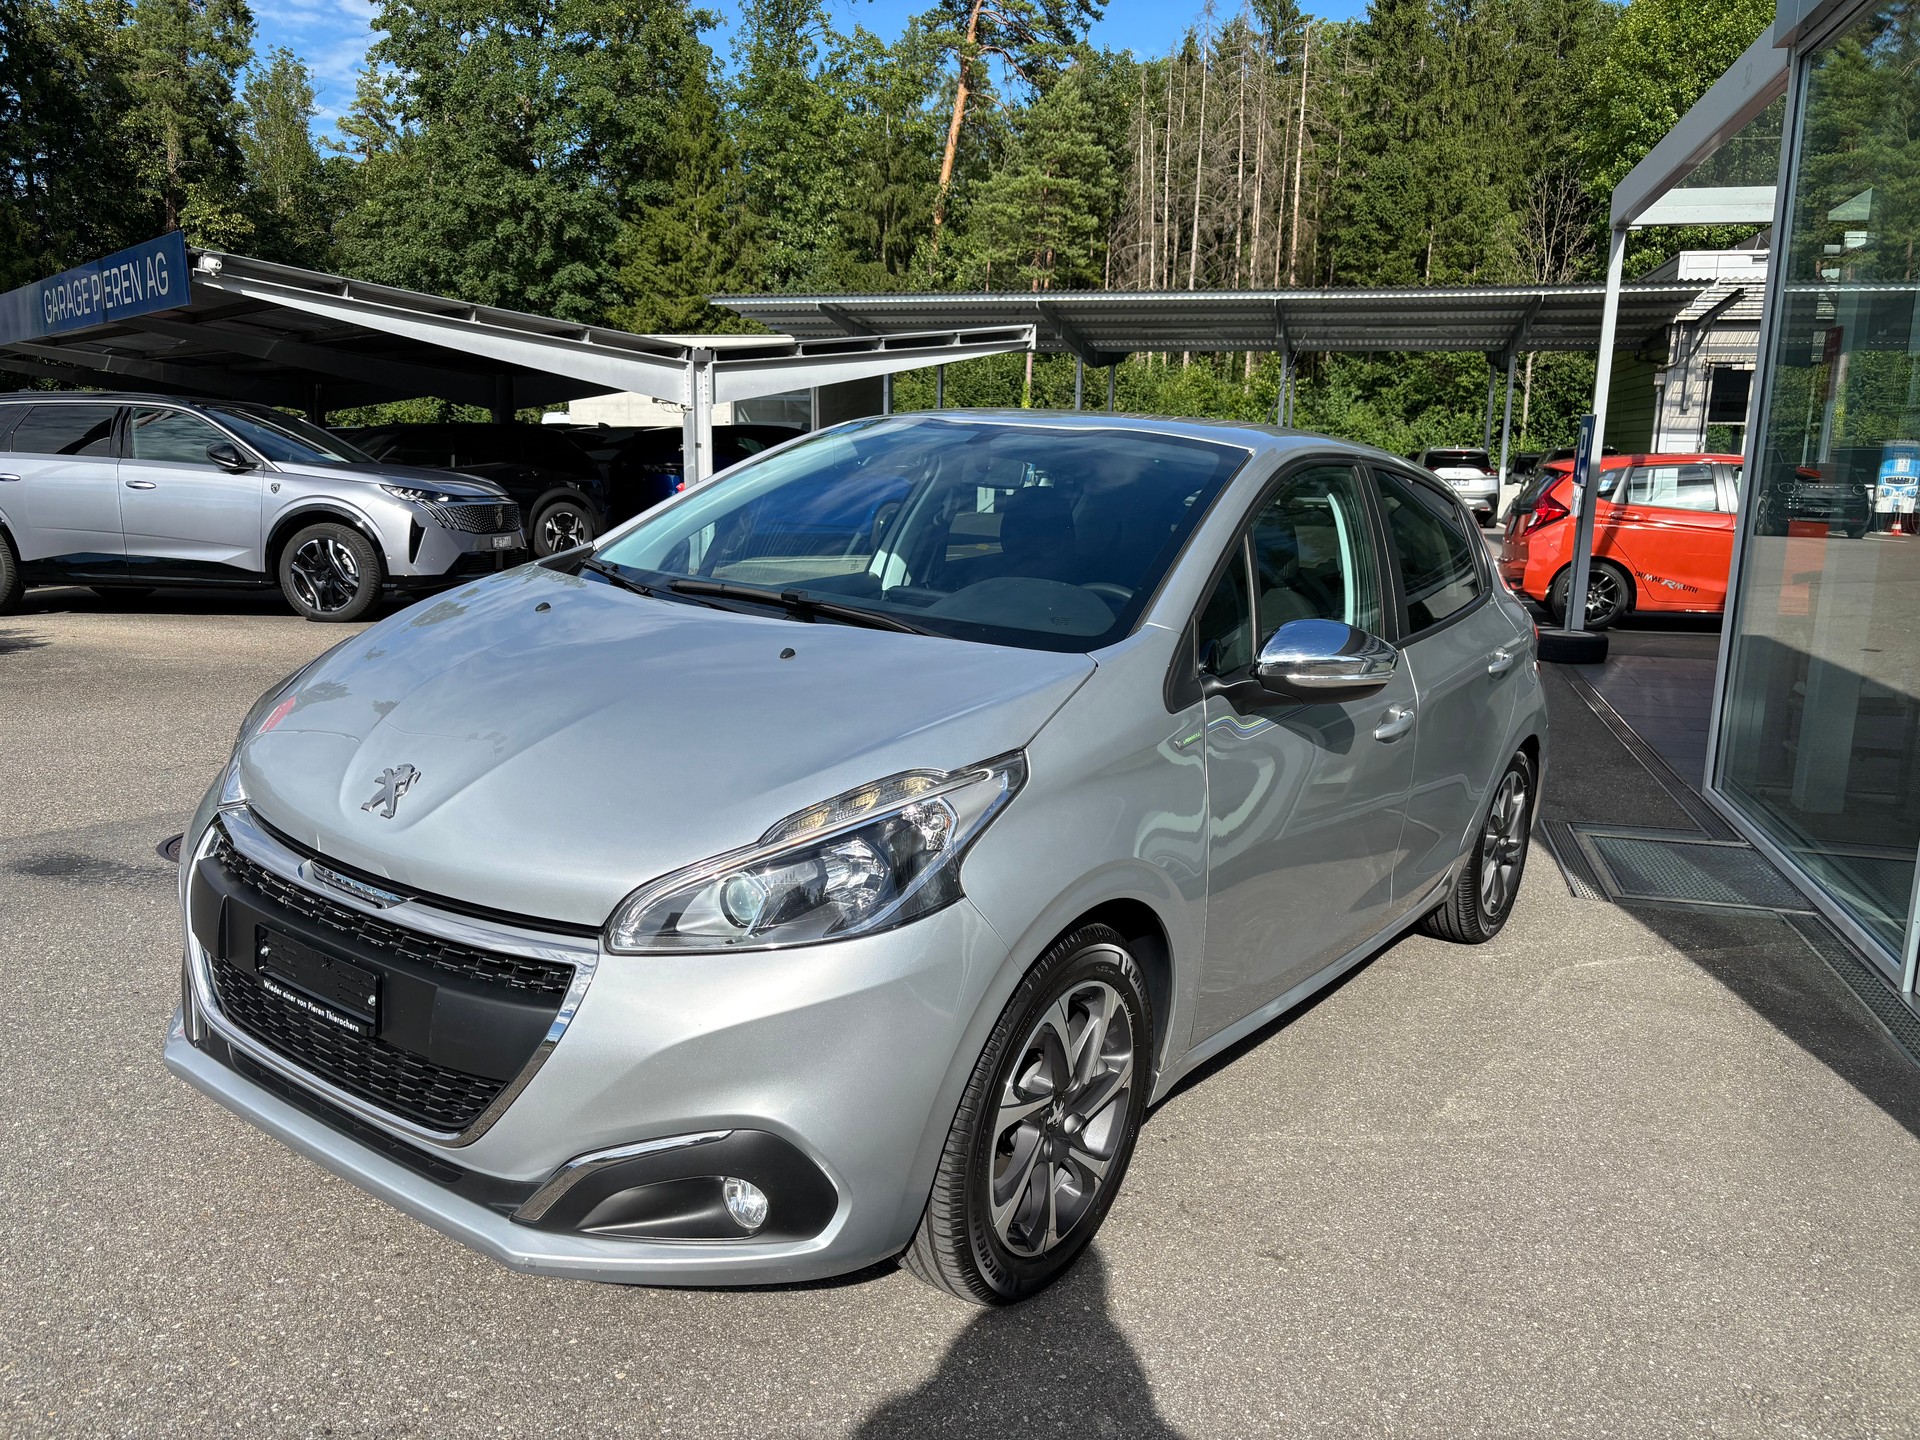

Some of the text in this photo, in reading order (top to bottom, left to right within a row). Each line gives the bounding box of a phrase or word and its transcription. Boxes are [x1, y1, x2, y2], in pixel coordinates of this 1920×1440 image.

[44, 251, 169, 323] GARAGE PIEREN AG
[1576, 427, 1589, 476] P
[263, 979, 359, 1033] Wieder einer von Pieren Thierachern
